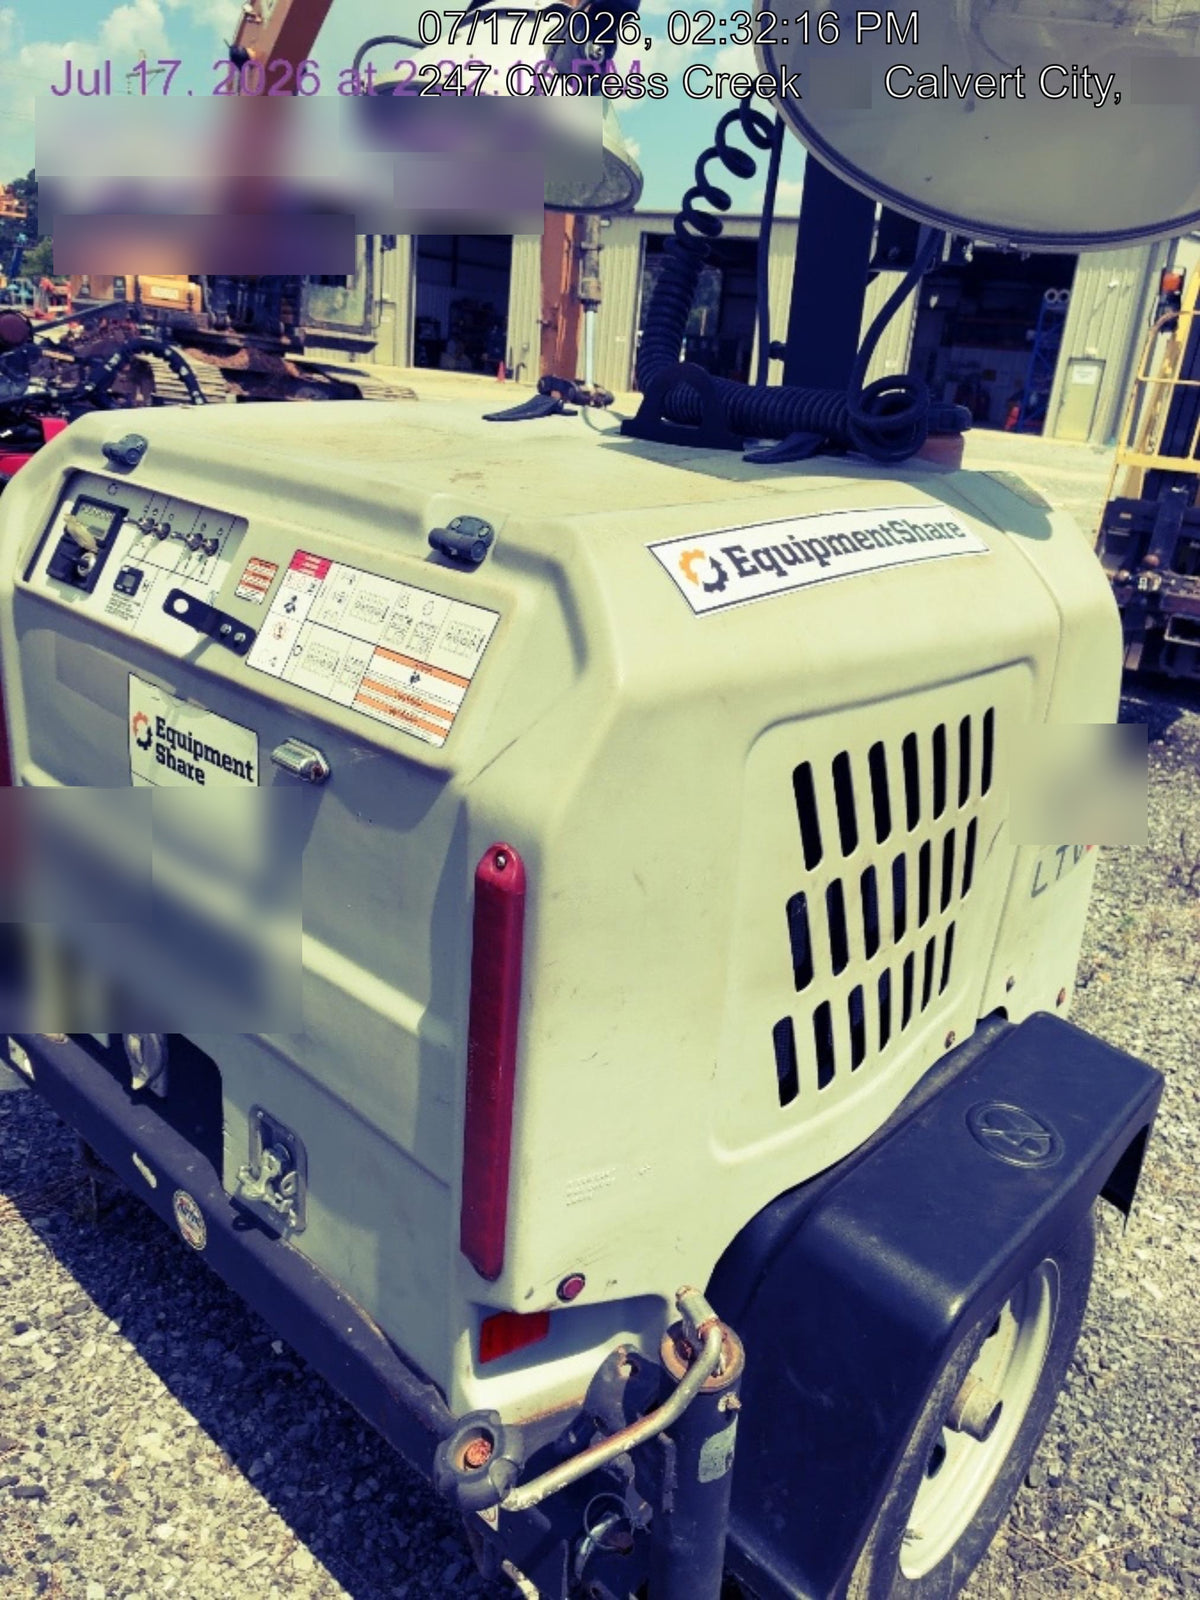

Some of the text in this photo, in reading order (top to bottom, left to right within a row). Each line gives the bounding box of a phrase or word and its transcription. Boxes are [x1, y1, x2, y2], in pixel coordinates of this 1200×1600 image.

[720, 518, 968, 578] EquipmentShare
[155, 715, 255, 783] Equipment
[155, 742, 206, 786] Share
